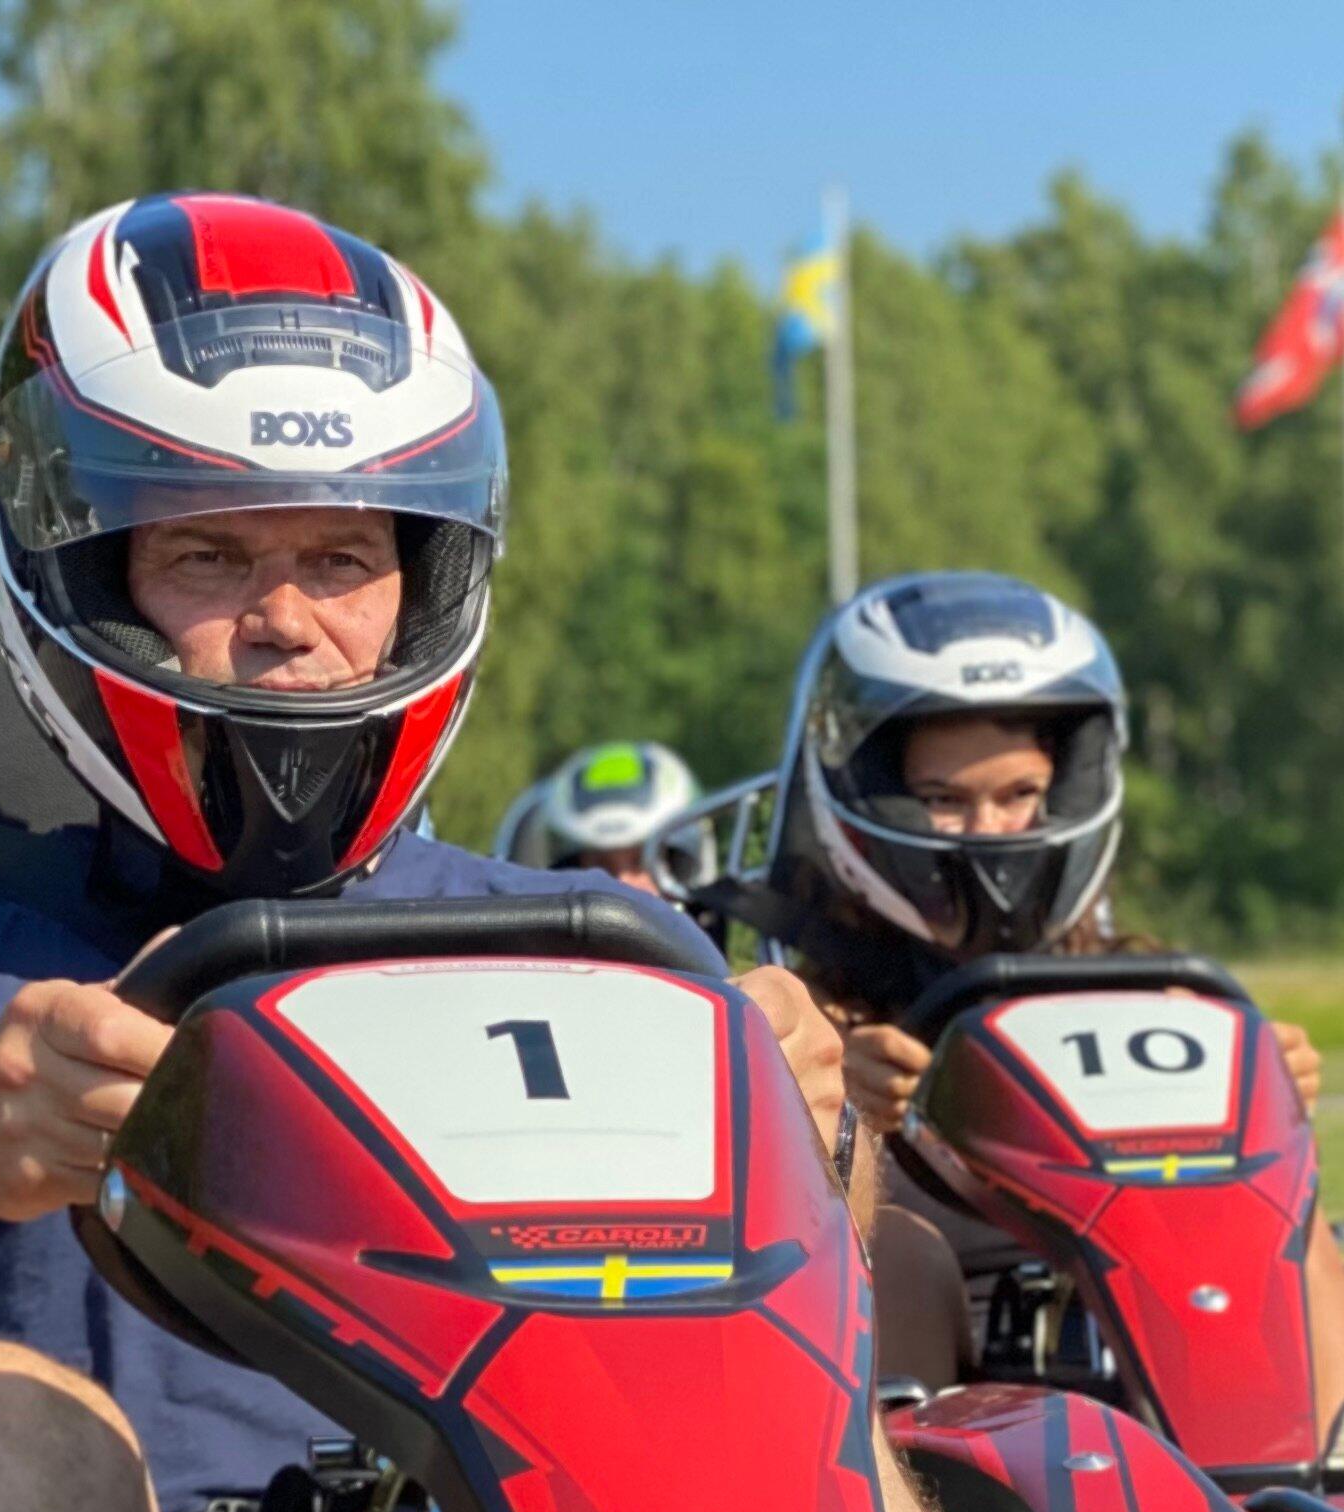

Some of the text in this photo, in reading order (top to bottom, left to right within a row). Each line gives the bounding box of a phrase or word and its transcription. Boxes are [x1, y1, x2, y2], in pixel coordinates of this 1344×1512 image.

[485, 1019, 571, 1100] 1
[1061, 1028, 1206, 1078] 10
[555, 1227, 692, 1242] CAROLI
